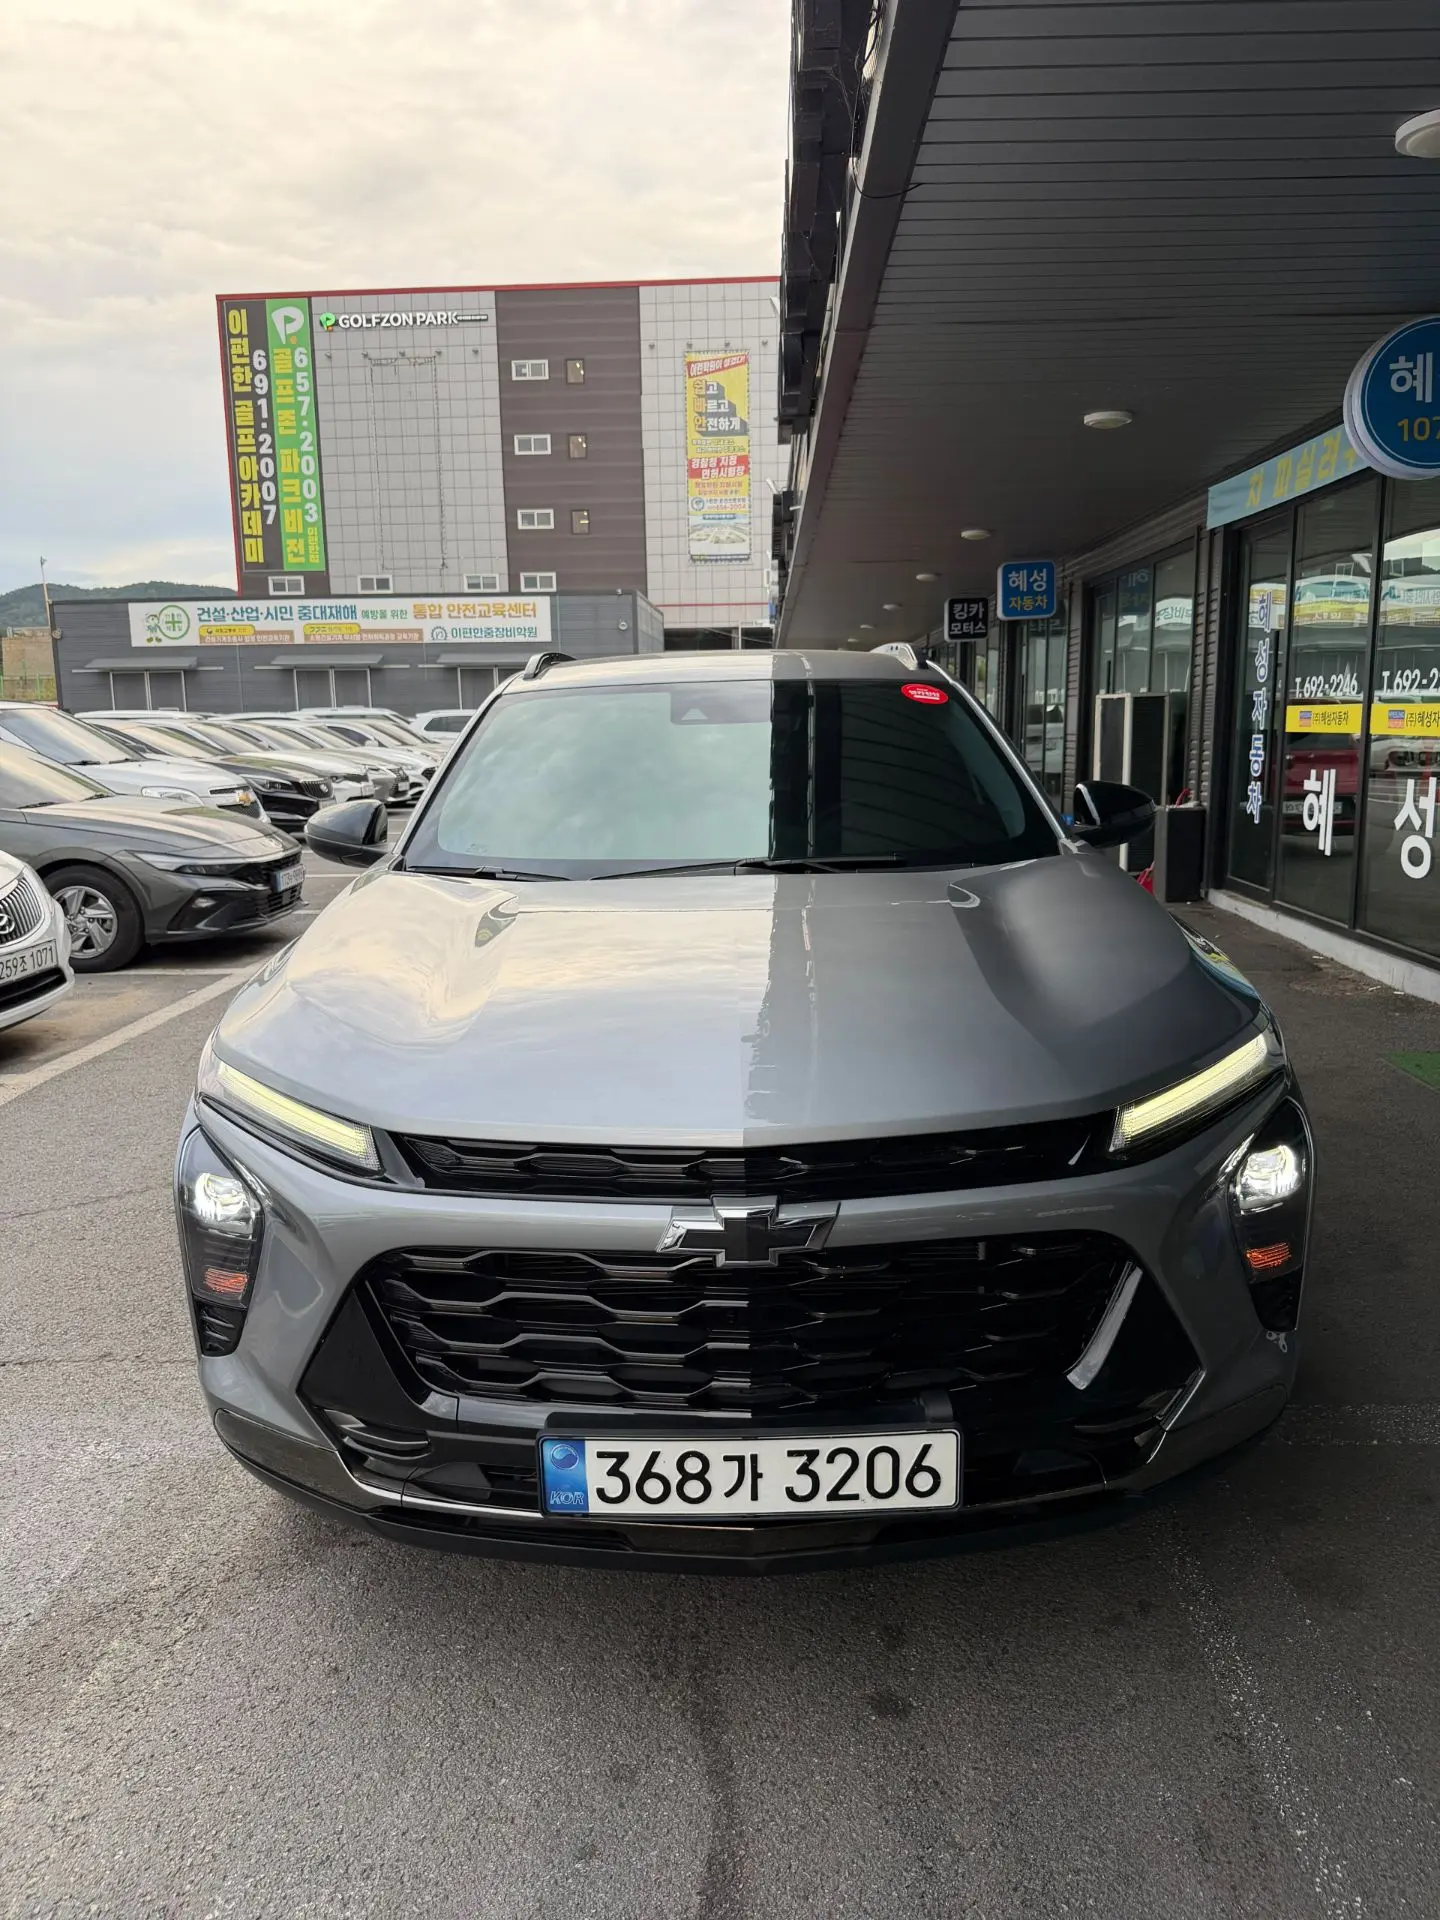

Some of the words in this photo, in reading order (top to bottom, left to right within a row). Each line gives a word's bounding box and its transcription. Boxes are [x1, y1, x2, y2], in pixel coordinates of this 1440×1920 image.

[338, 313, 413, 329] GOLFZON
[416, 312, 459, 327] PARK
[228, 308, 252, 392] 이편한
[1389, 352, 1434, 404] 혜
[693, 397, 730, 413] 빠르고
[694, 415, 740, 433] 안전하게
[235, 400, 265, 563] 골프아카데미
[1008, 568, 1048, 592] 혜성
[297, 603, 358, 621] 중대재해
[361, 608, 388, 620] 예방을
[390, 608, 409, 619] 위한
[412, 603, 443, 620] 통합
[446, 601, 537, 619] 안전교육센터
[952, 601, 985, 620] 킹카
[1008, 594, 1049, 612] 자동차
[950, 621, 988, 636] 모터스
[1381, 667, 1440, 696] T.692-2
[1246, 591, 1273, 825] 혜성자동차
[1312, 710, 1349, 727] (주)혜성자동차
[1303, 769, 1336, 856] 혜
[1394, 777, 1437, 879] 성
[30, 945, 54, 970] 1071
[595, 1450, 765, 1505] 368가
[784, 1443, 942, 1502] 3206
[550, 1490, 585, 1505] KOR
